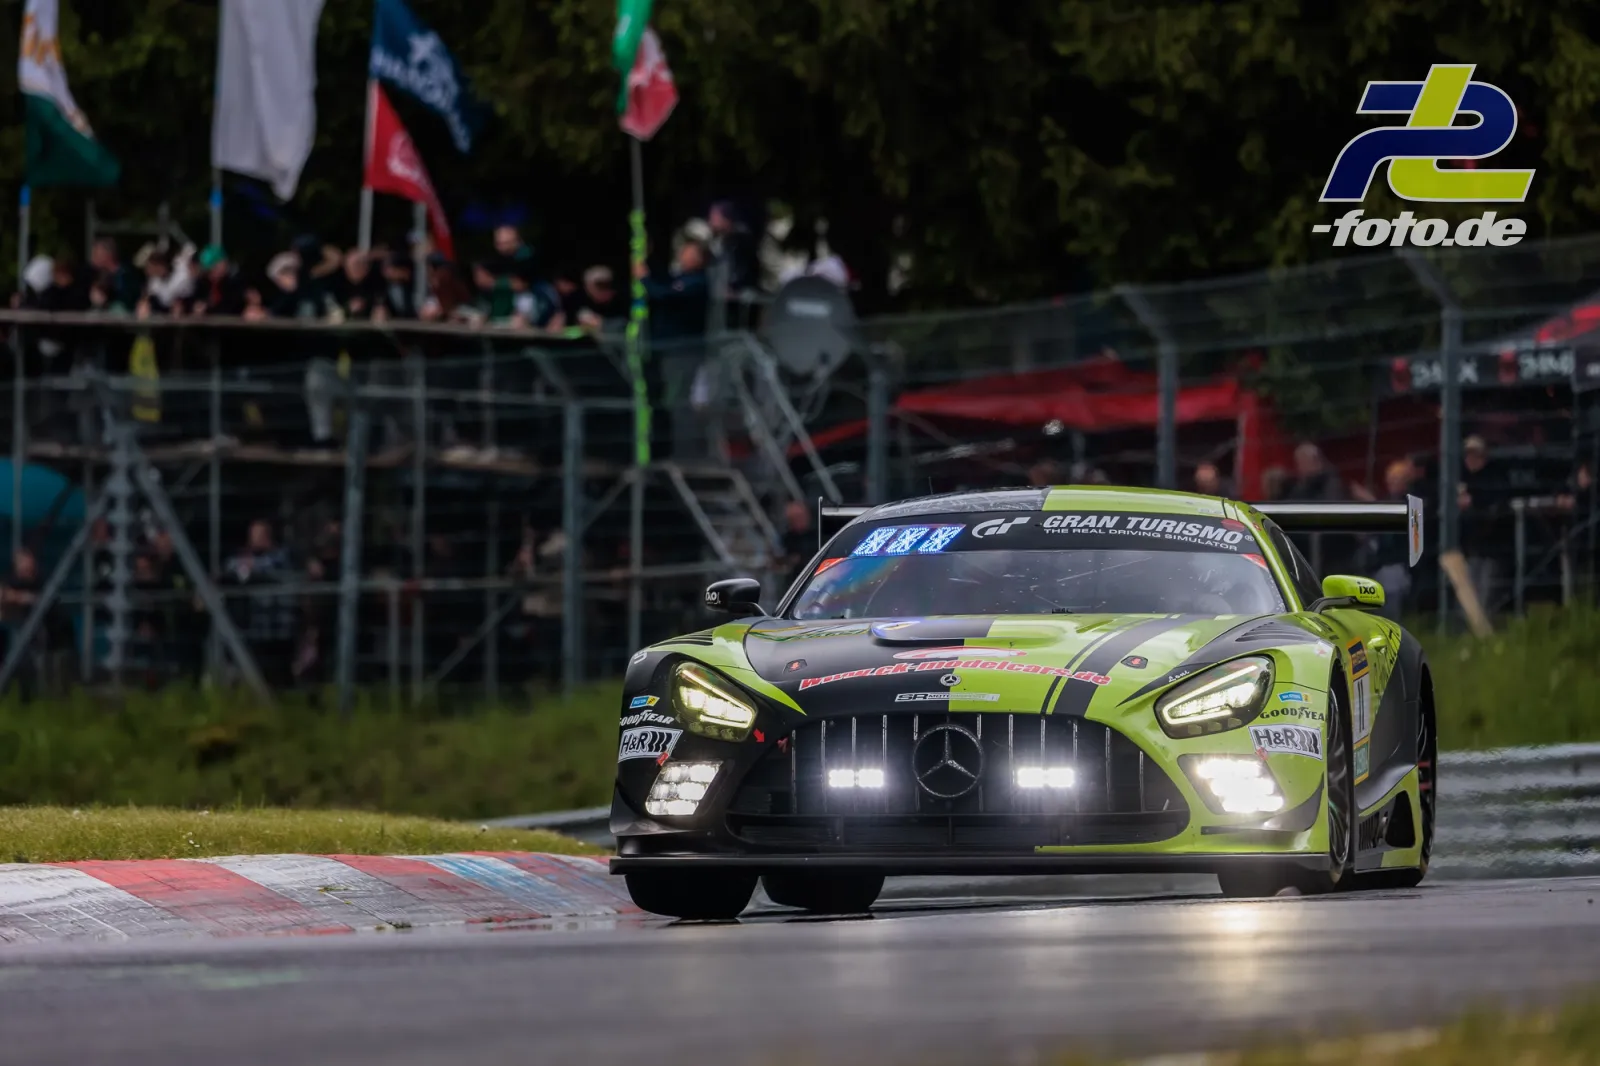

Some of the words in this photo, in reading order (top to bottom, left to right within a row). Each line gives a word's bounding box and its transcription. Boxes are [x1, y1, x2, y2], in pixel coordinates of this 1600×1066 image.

[1043, 515, 1120, 528] GRAN
[1127, 516, 1243, 545] TURISMO
[1109, 529, 1161, 538] DRIVING
[1164, 533, 1238, 551] SIMULATOR
[1359, 585, 1376, 595] IXO
[798, 659, 1112, 691] www.ck-modelcars.de
[898, 693, 929, 701] SR
[1260, 706, 1328, 721] GOODYEA
[620, 731, 650, 756] H&R
[1253, 728, 1299, 749] H&R
